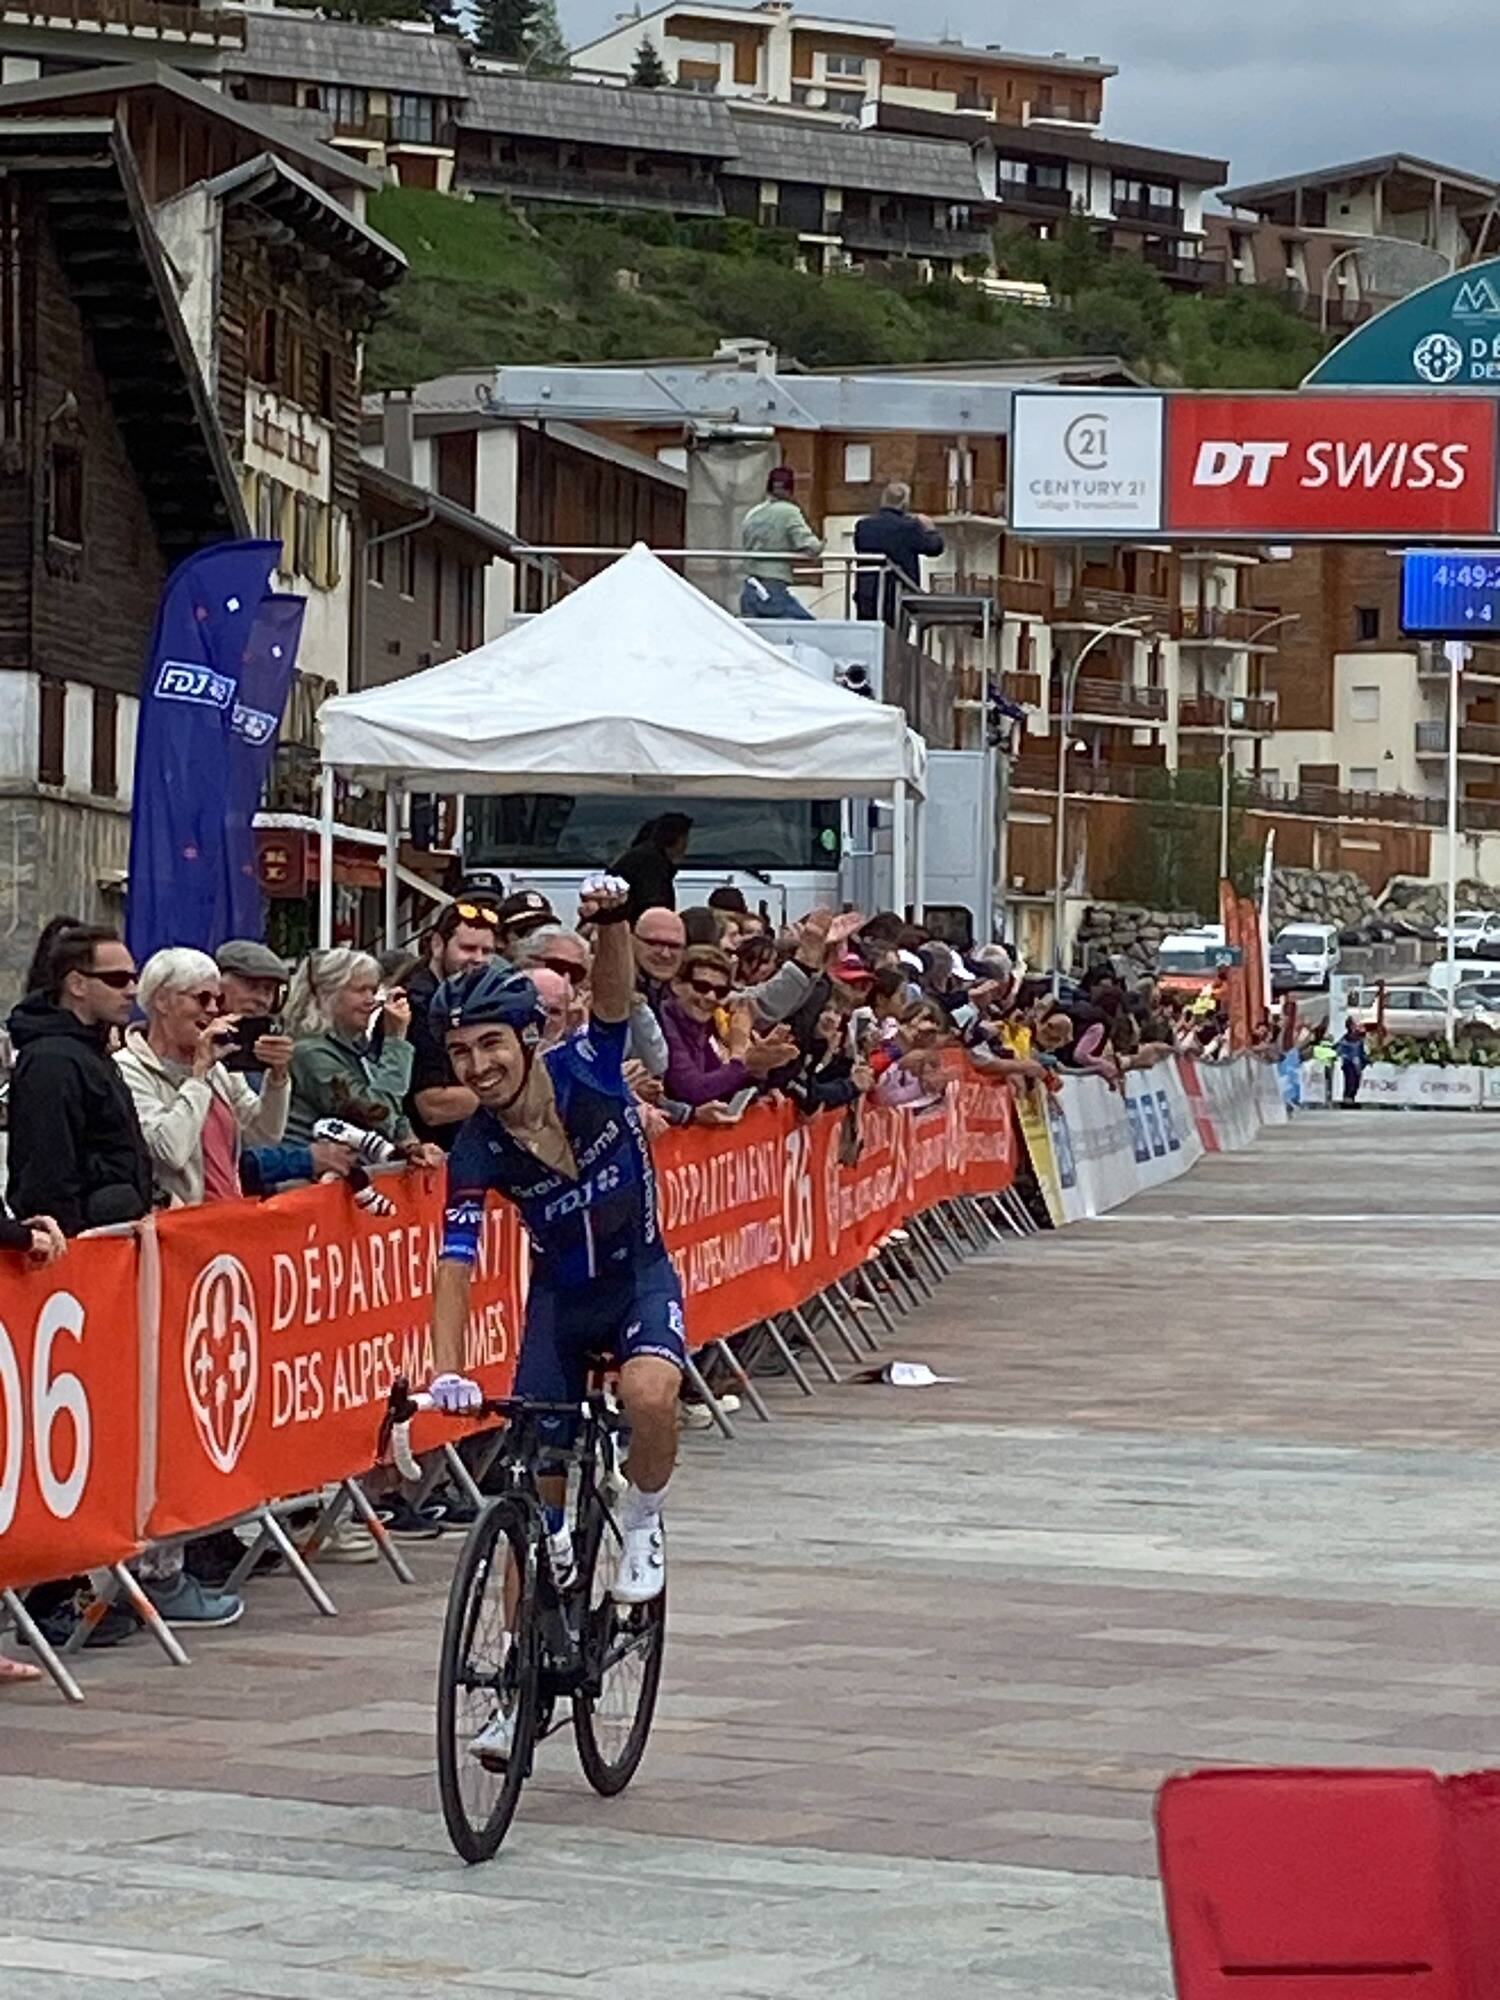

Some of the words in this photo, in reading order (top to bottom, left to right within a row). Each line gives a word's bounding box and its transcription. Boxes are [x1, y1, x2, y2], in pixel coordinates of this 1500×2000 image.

[1029, 478, 1123, 496] CENTURY
[1193, 441, 1289, 486] DT
[1300, 441, 1468, 489] SWISS
[163, 669, 209, 695] FDJ
[545, 1181, 592, 1221] FDJ
[272, 1208, 503, 1331] DÉPARTENT
[272, 1351, 324, 1428] DES
[333, 1302, 508, 1413] ALPES-MAIMES
